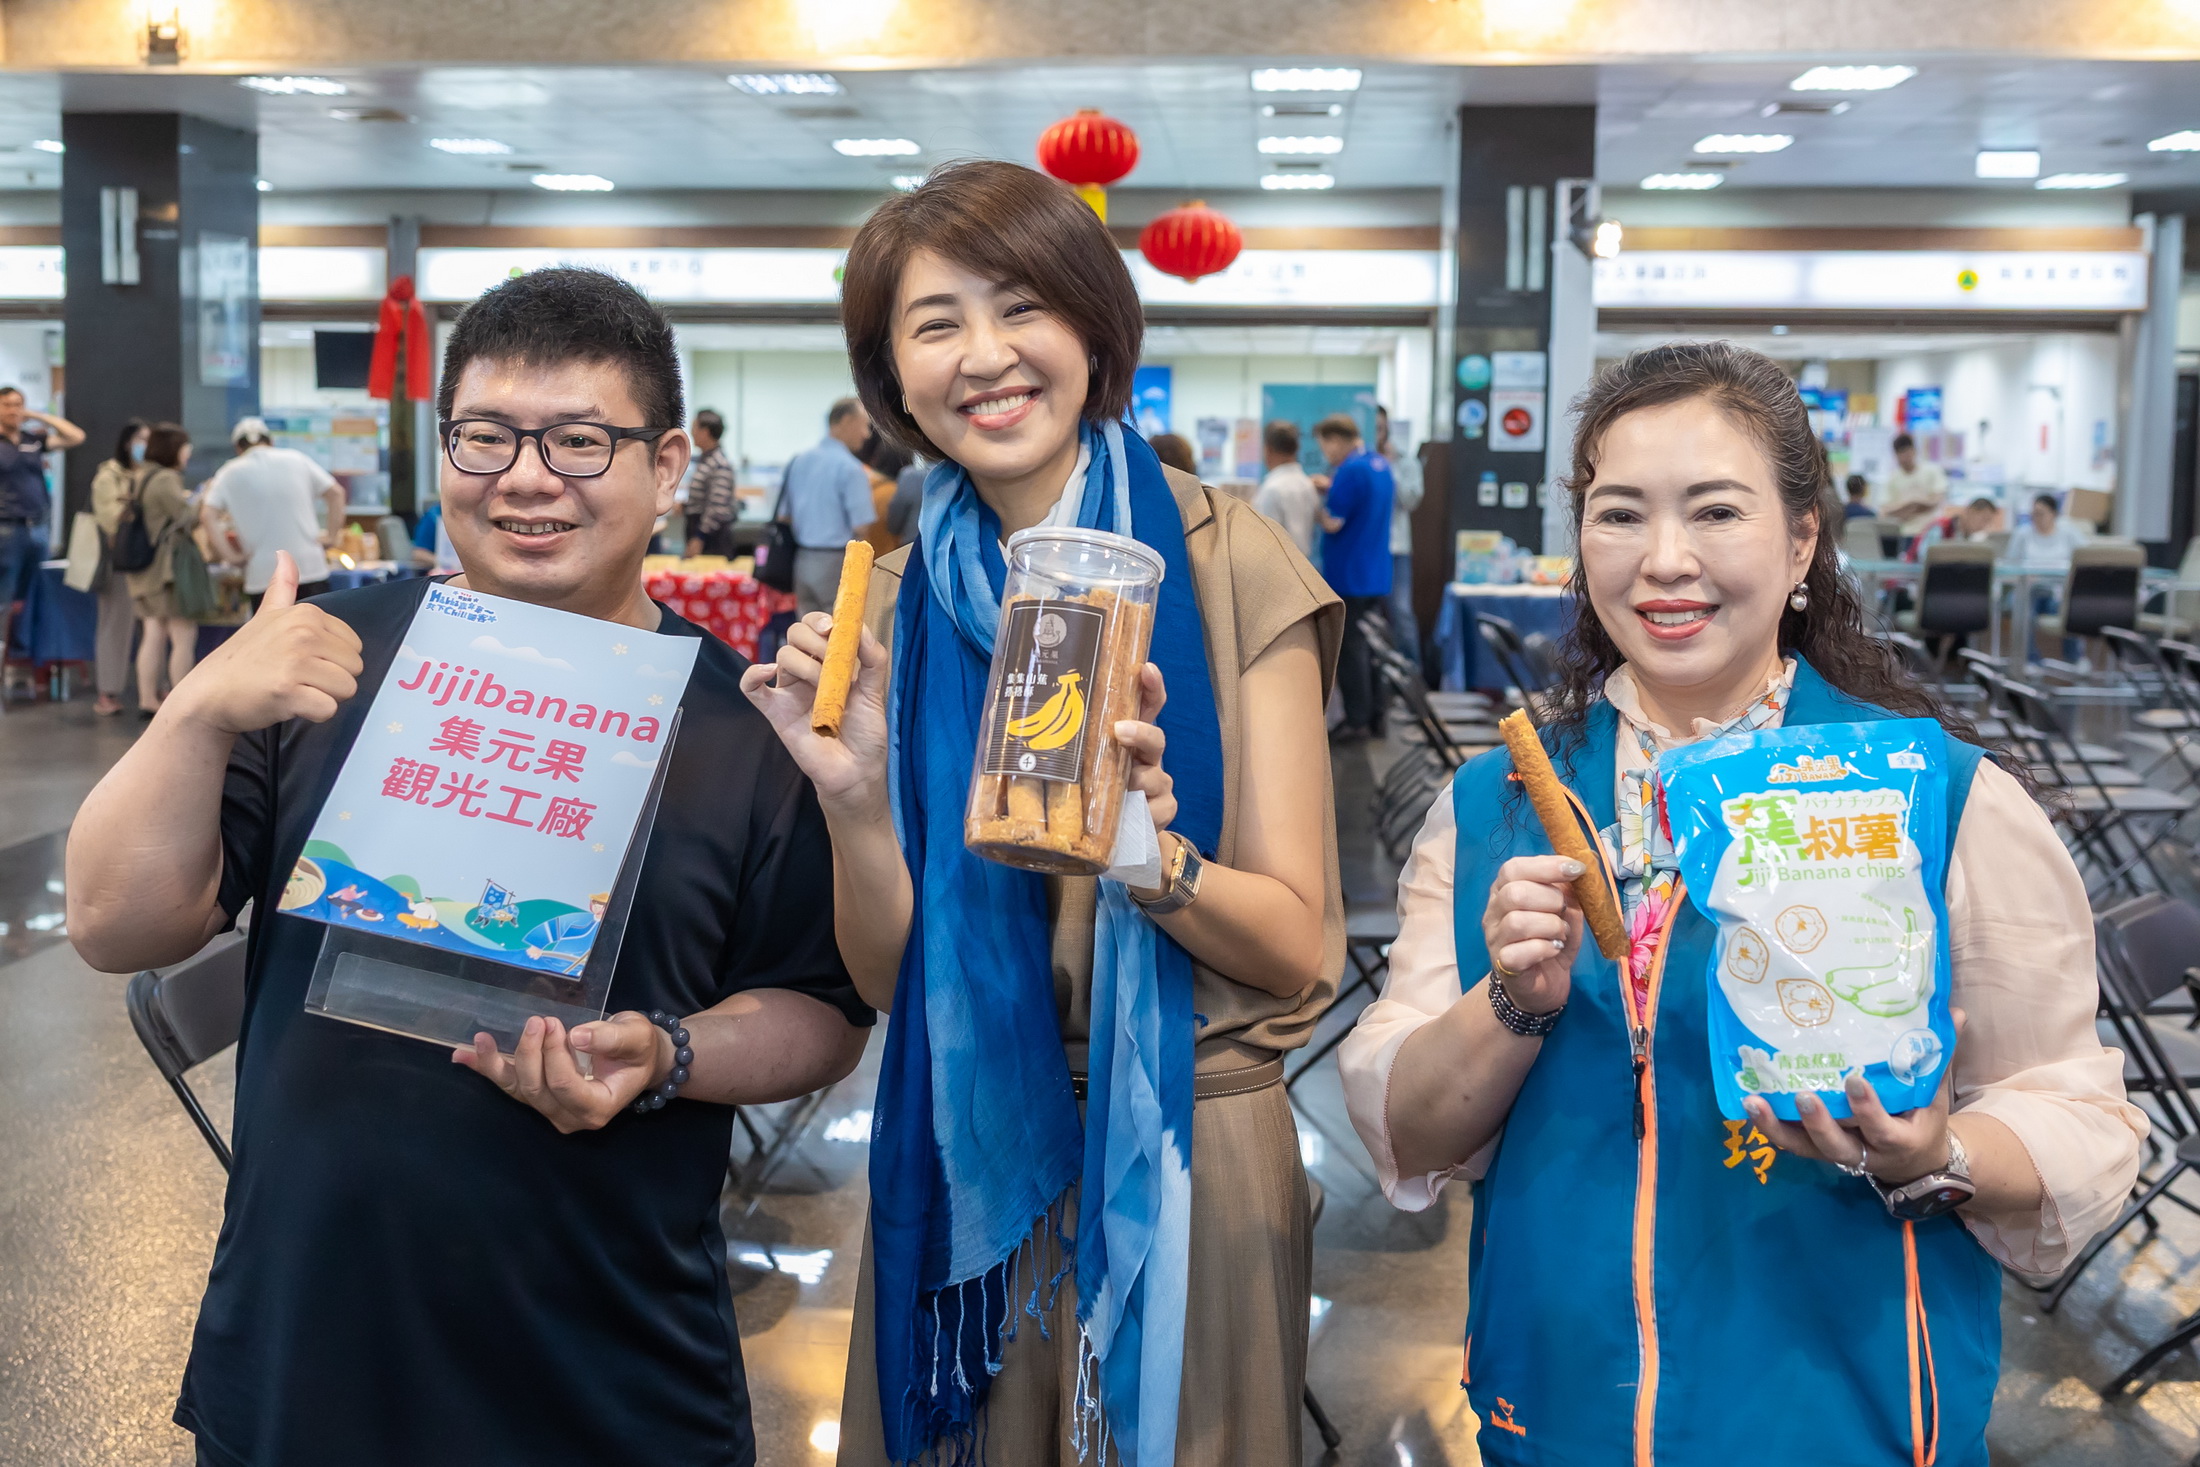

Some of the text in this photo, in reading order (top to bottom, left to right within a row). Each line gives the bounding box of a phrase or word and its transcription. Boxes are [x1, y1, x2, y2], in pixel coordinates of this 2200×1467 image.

[398, 661, 660, 743] Jijibanana
[429, 715, 587, 783] 集元果
[381, 757, 597, 841] 觀光工廠
[1804, 793, 1903, 809] バナナチップス
[1737, 862, 1906, 887] Jiji Banana chips
